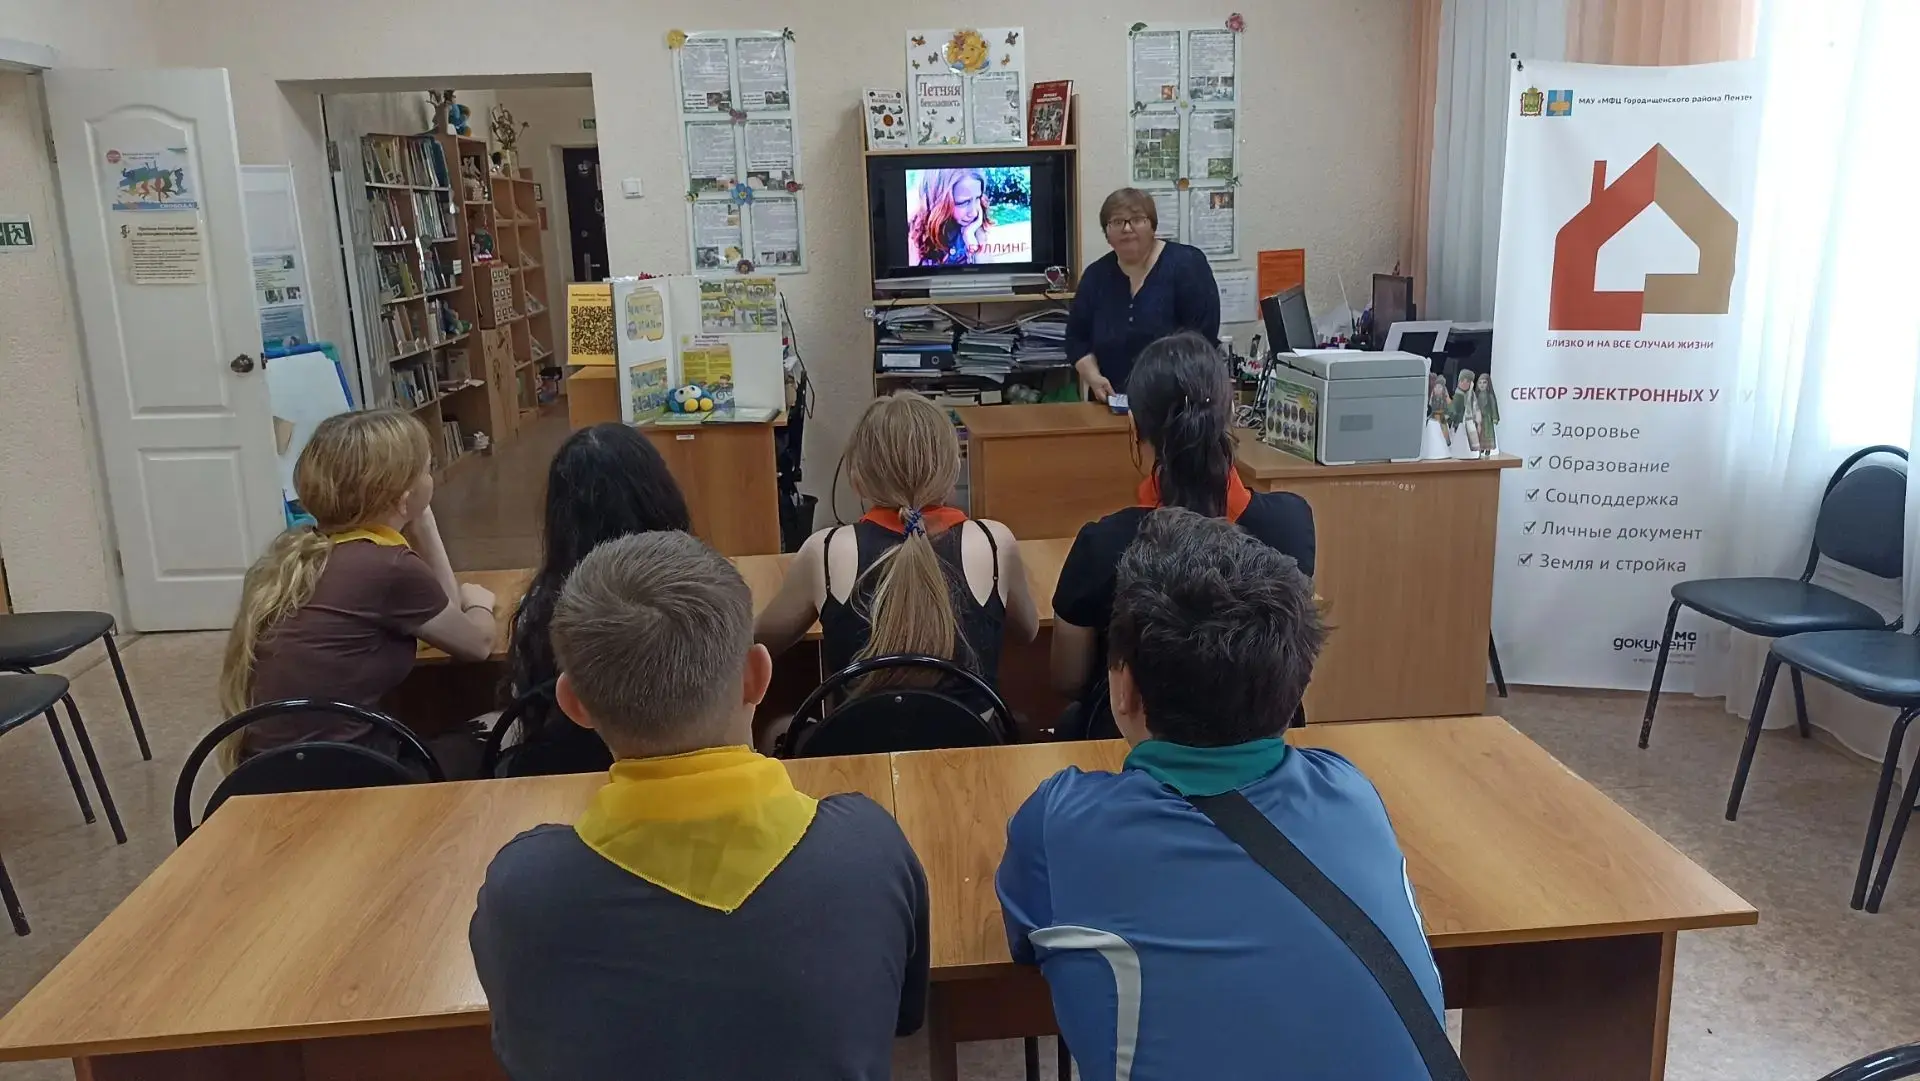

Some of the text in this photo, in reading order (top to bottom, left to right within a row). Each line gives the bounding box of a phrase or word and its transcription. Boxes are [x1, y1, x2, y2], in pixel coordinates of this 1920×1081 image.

[918, 82, 962, 97] Летняя
[1578, 97, 1596, 105] МАУ
[1623, 96, 1690, 106] Городищенского
[1691, 95, 1722, 104] района
[1546, 339, 1714, 350] БЛИЗКО И НА ВСЕ СЛУЧАИ ЖИЗНИ
[1510, 386, 1569, 401] СЕКТОР
[1572, 386, 1704, 403] ЭЛЕКТРОННЫХ
[1551, 421, 1640, 441] Здоровье
[1548, 455, 1670, 474] Образование
[1545, 488, 1679, 507] Соцподдержка
[1541, 520, 1703, 543] Личные документ
[1539, 553, 1687, 574] Земля и стройка
